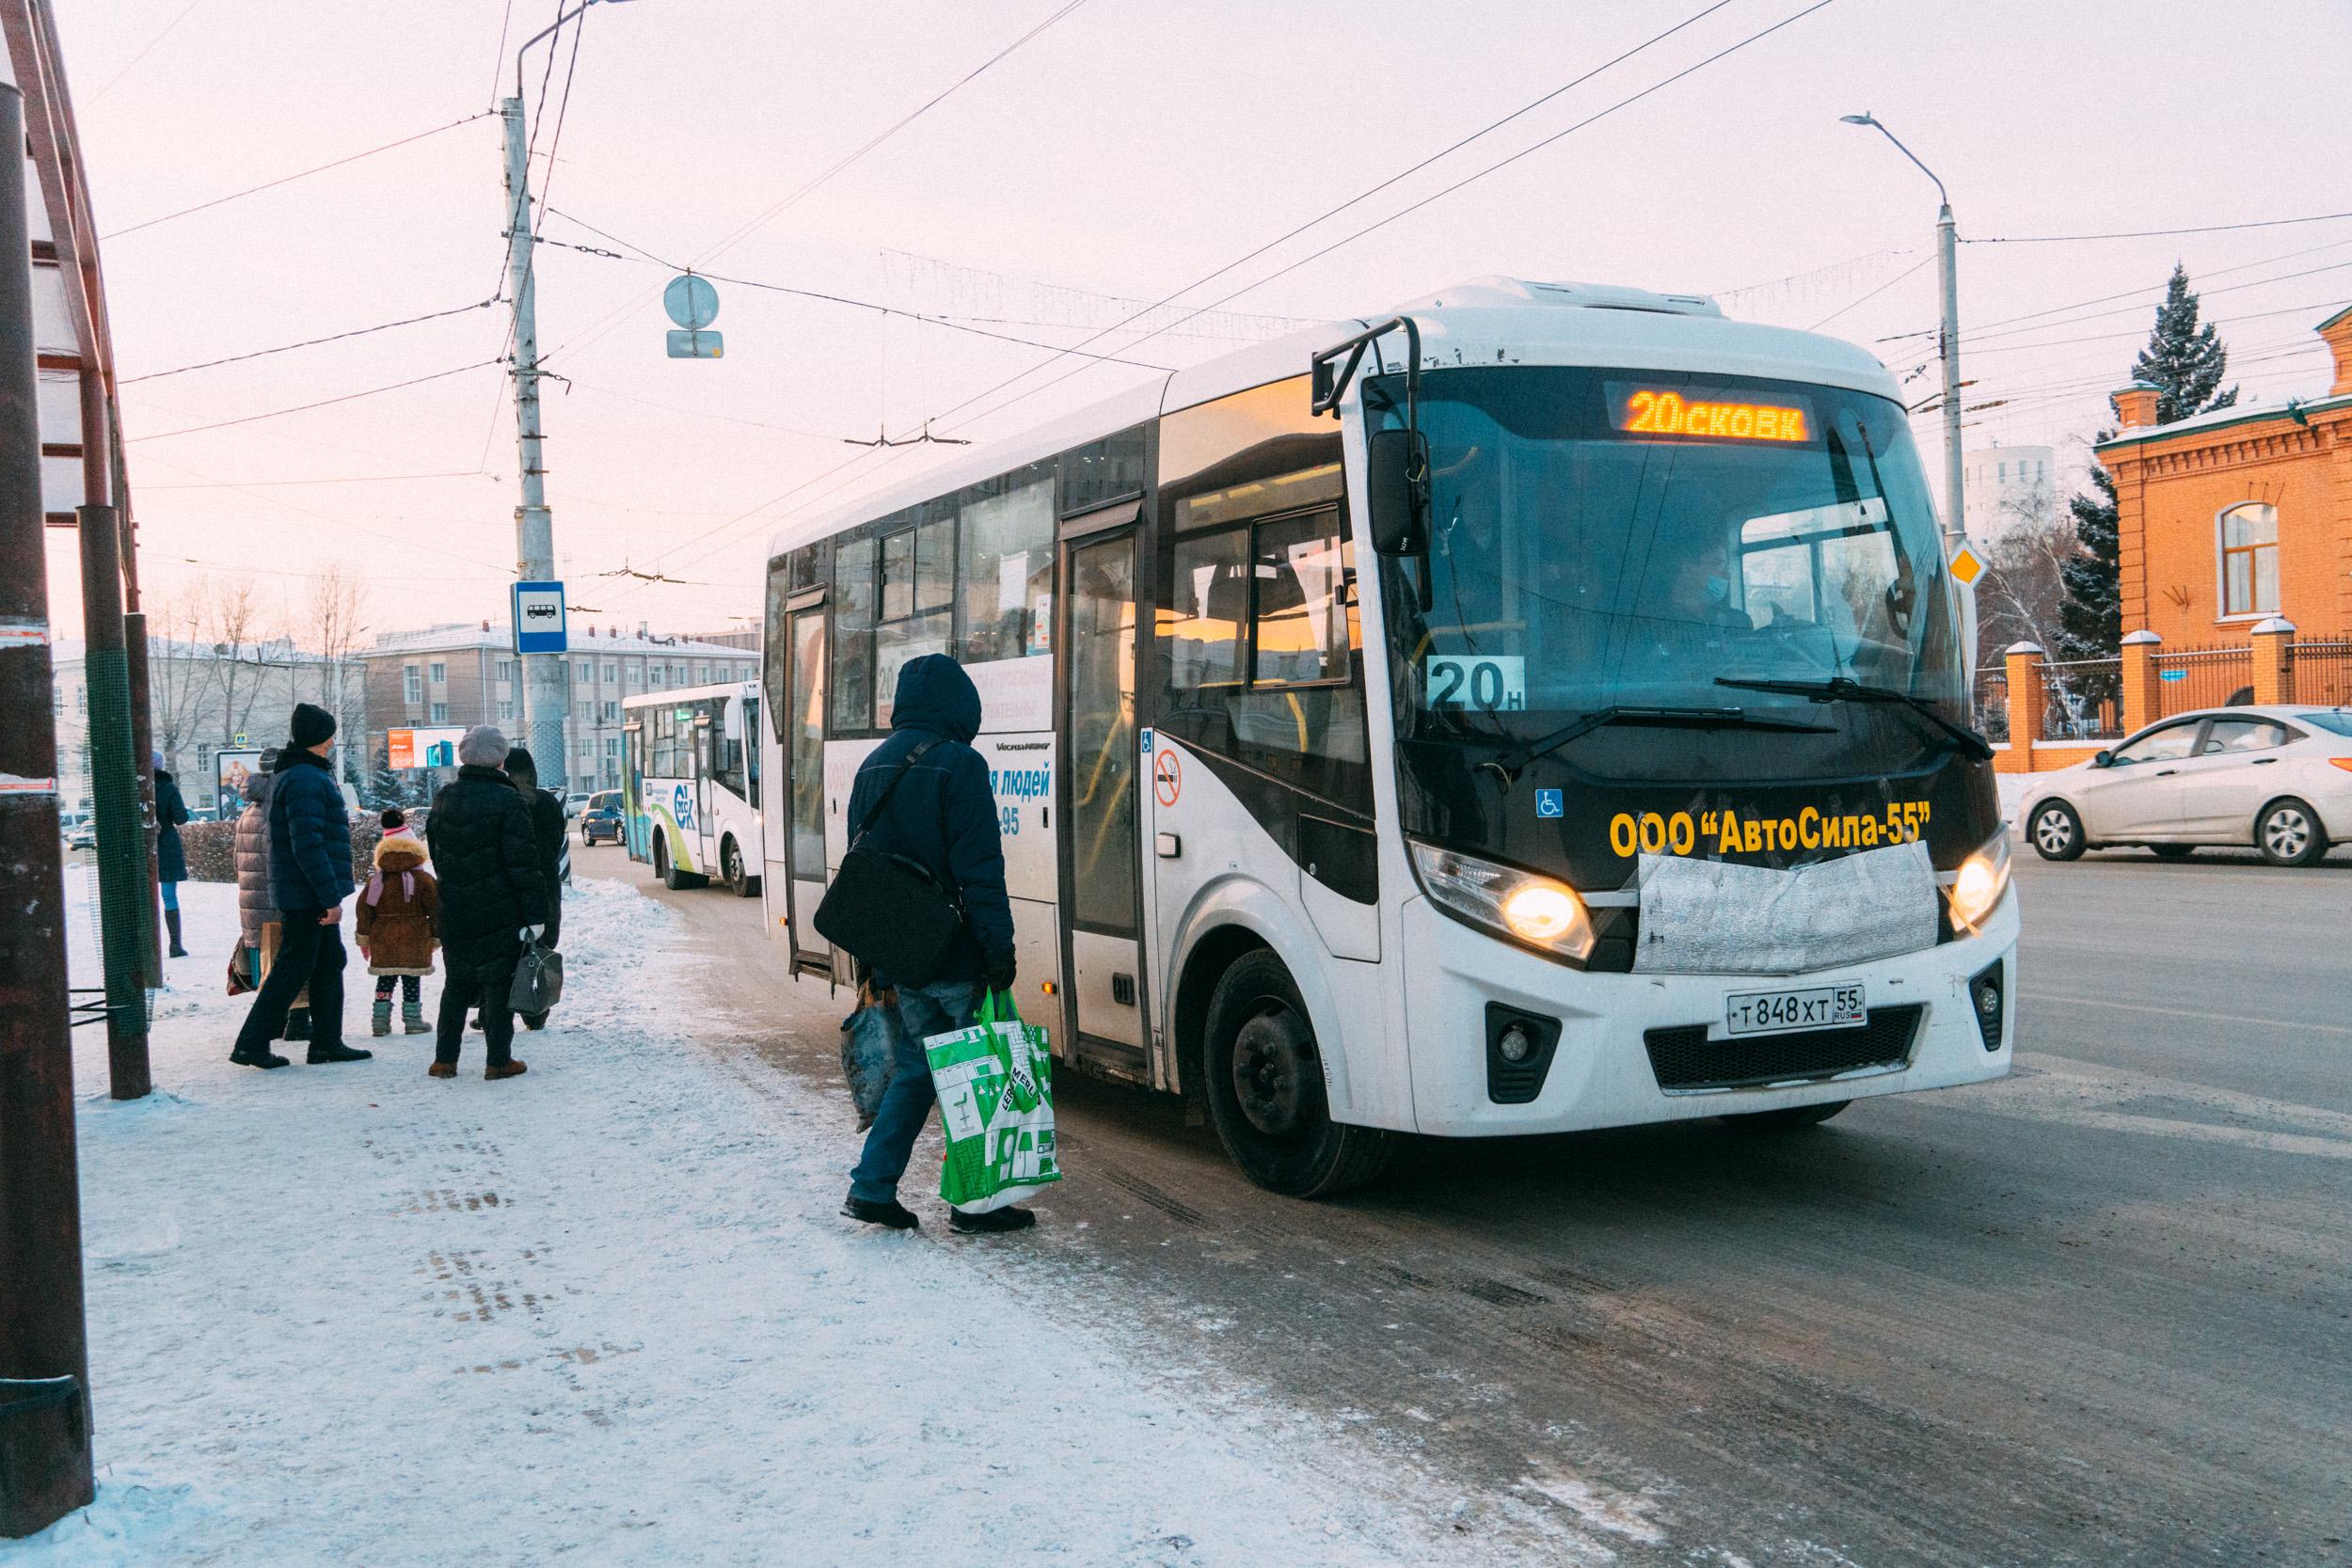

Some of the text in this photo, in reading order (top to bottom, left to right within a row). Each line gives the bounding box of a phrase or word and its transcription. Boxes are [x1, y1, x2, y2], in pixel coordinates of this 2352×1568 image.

[1001, 760, 1050, 802] людей
[1610, 812, 1694, 857] ООО
[1835, 1011, 1851, 1020] RUS
[1836, 990, 1857, 1010] 55
